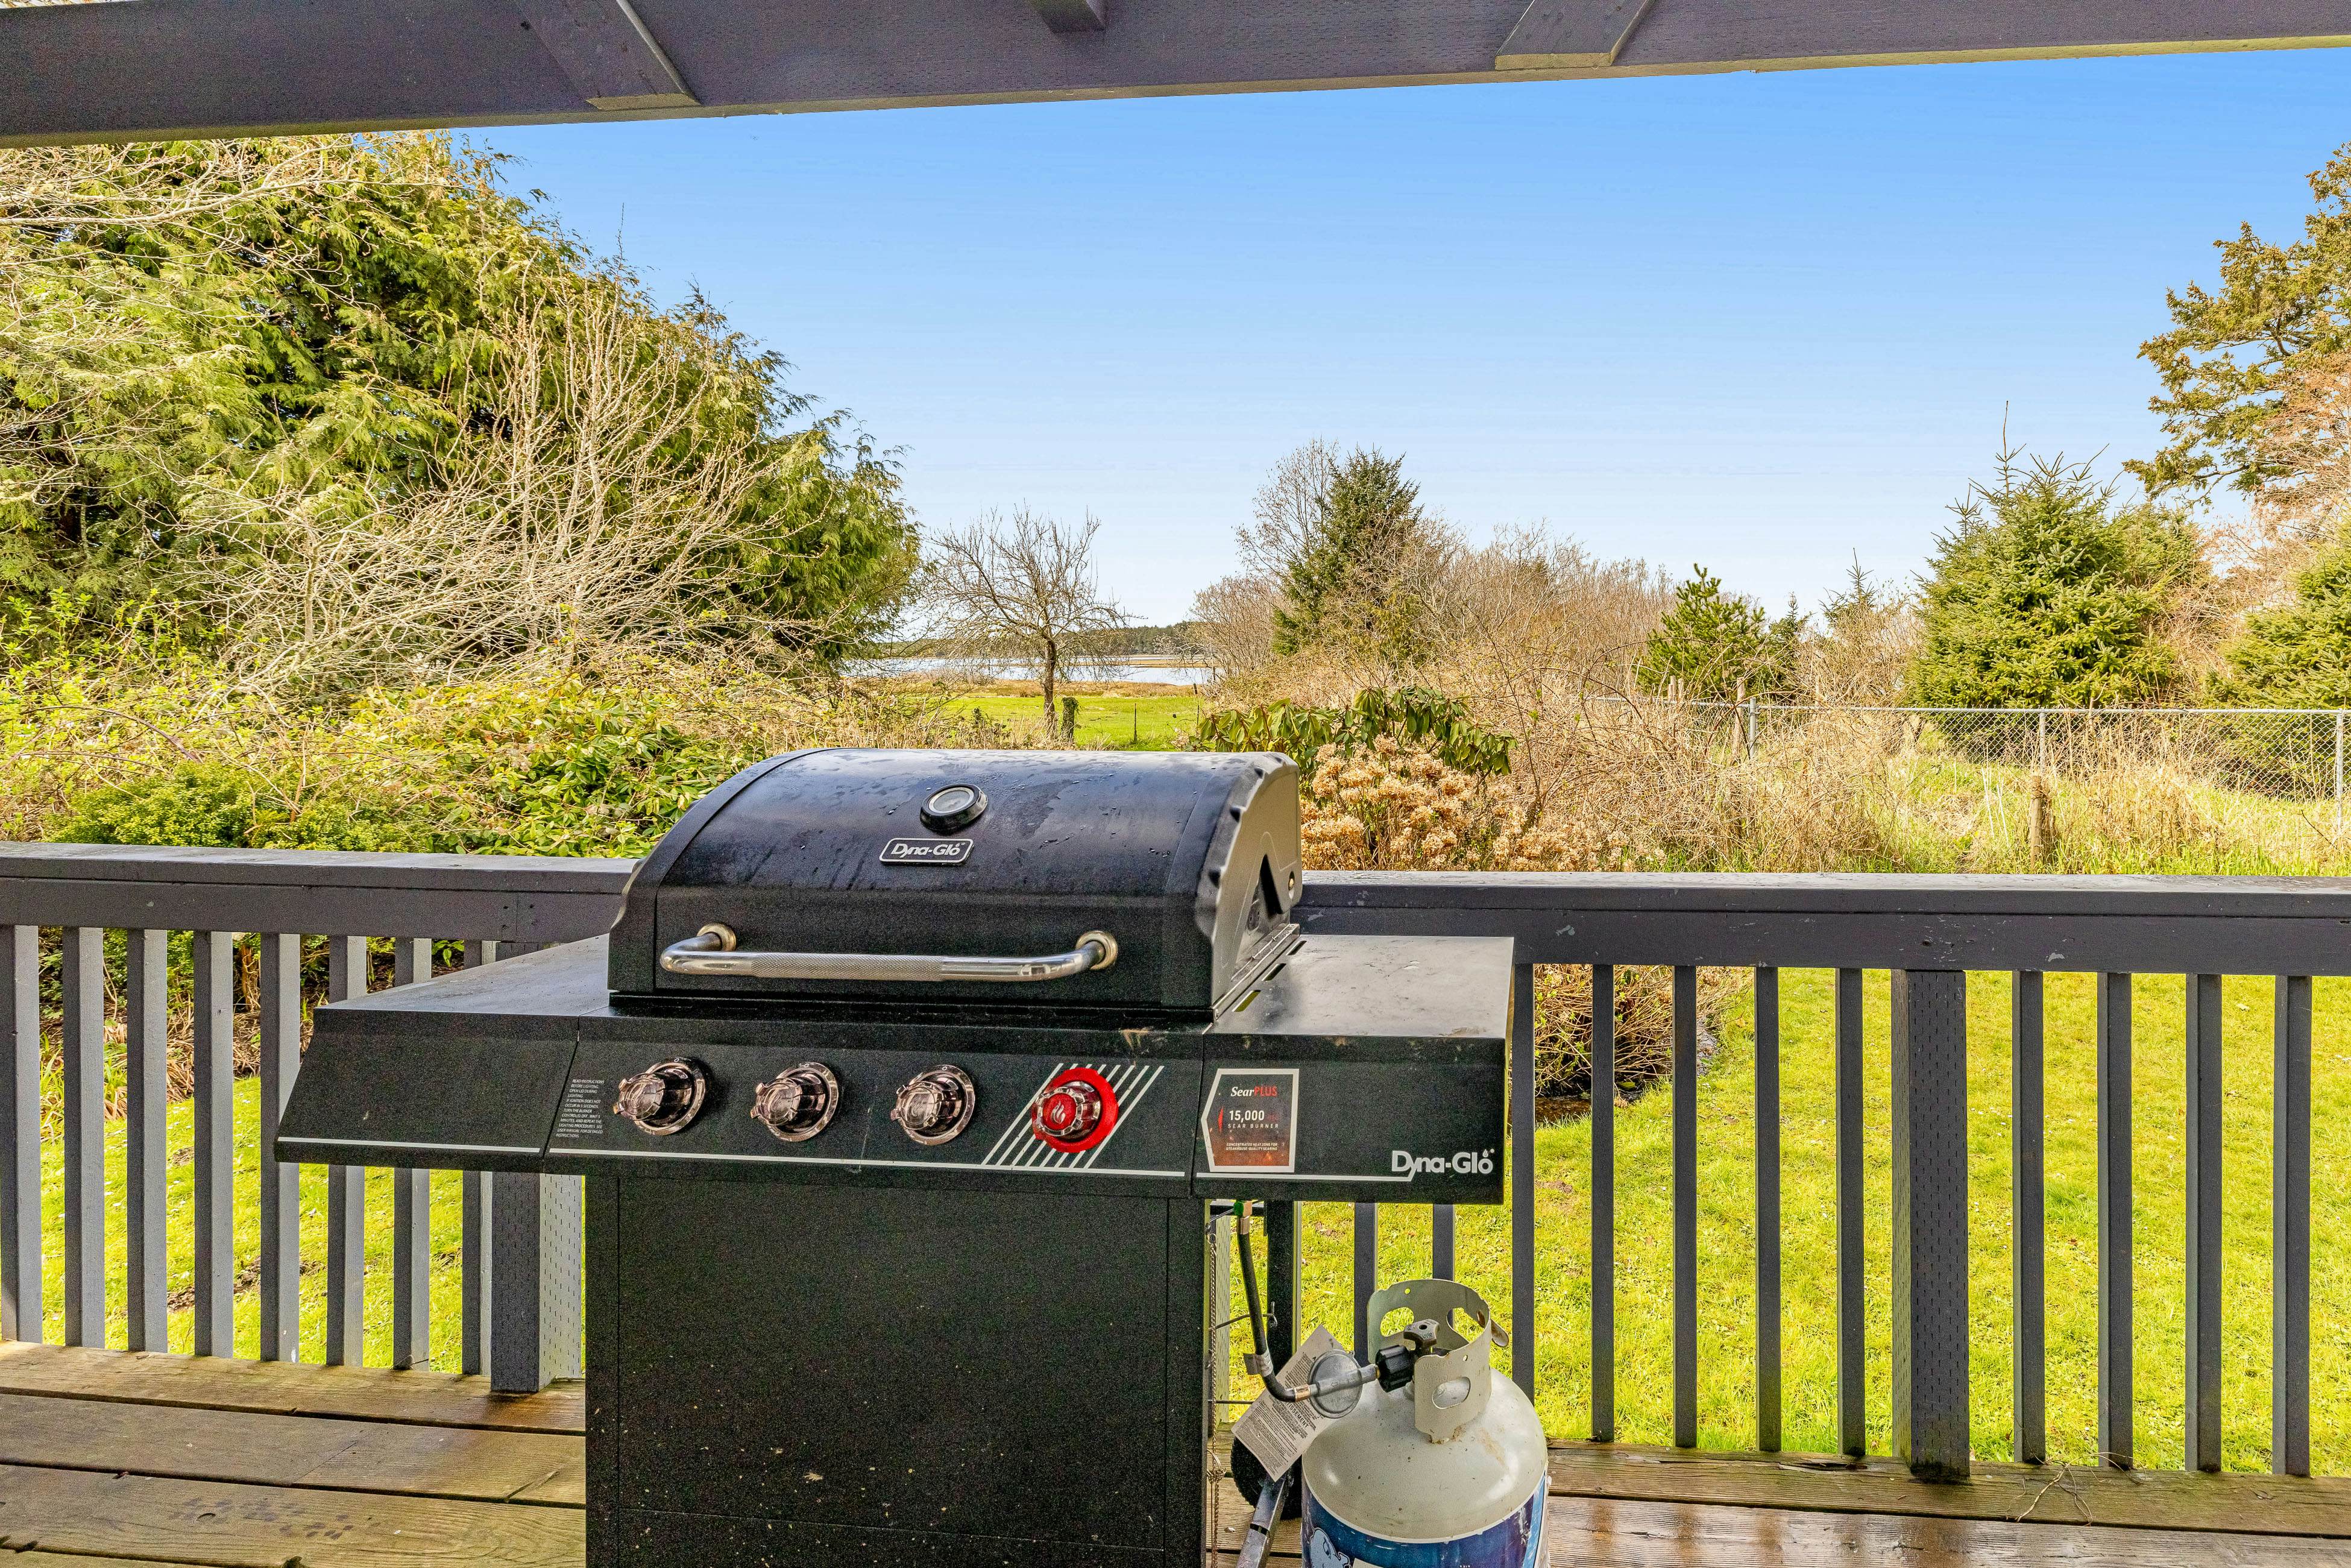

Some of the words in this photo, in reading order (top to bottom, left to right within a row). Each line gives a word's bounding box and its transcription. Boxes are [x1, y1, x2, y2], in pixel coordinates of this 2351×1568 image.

[891, 842, 960, 858] Dyna-Glo
[1229, 1110, 1265, 1123] 15,000
[1391, 1149, 1494, 1181] Dyna-Glo
